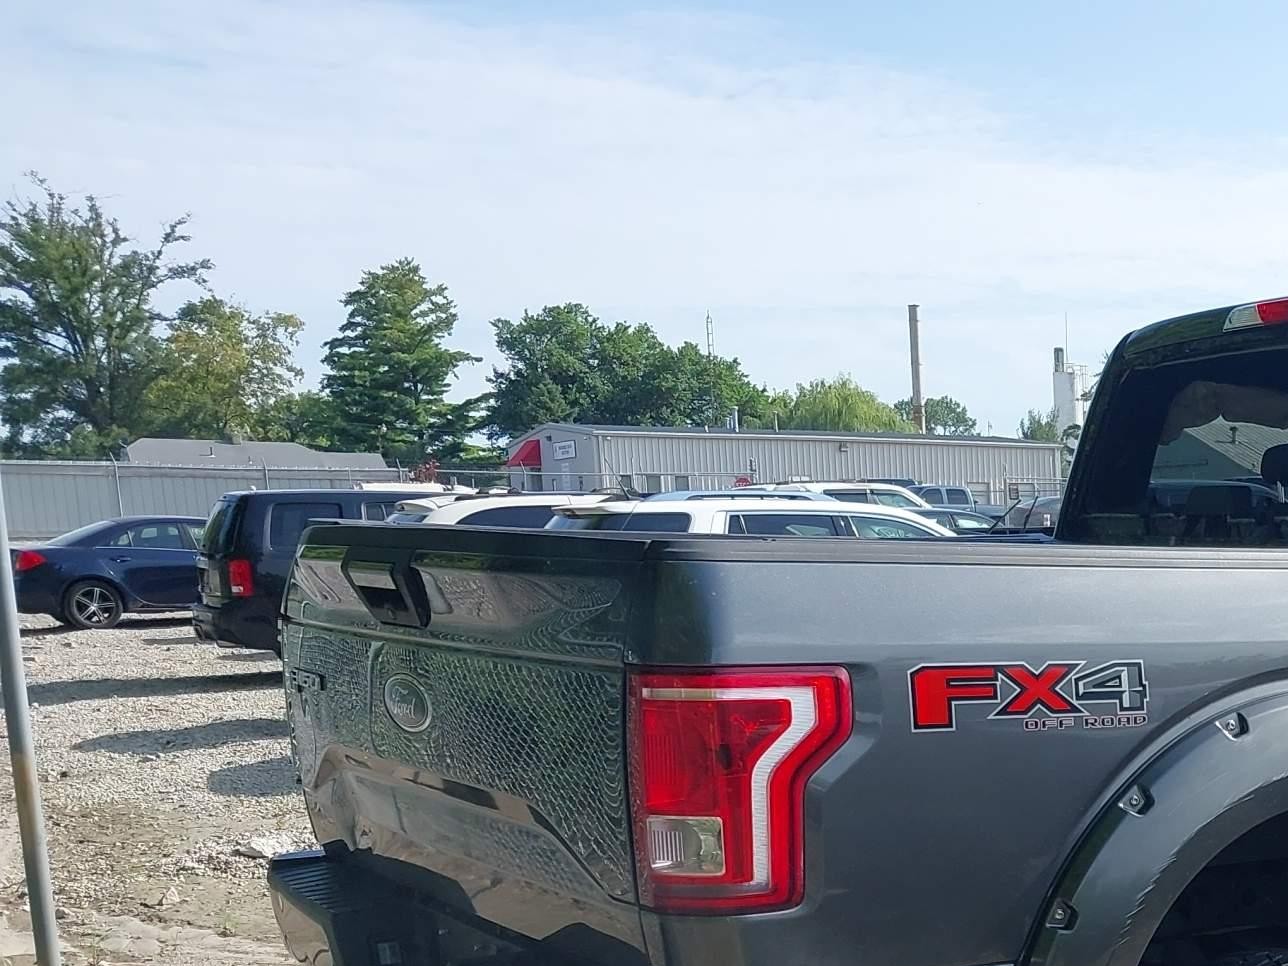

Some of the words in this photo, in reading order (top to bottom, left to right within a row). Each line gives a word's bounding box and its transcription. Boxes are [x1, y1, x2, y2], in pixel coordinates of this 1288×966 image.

[907, 660, 1149, 732] FX4
[1023, 717, 1075, 731] OFF
[1083, 715, 1147, 730] ROAD
